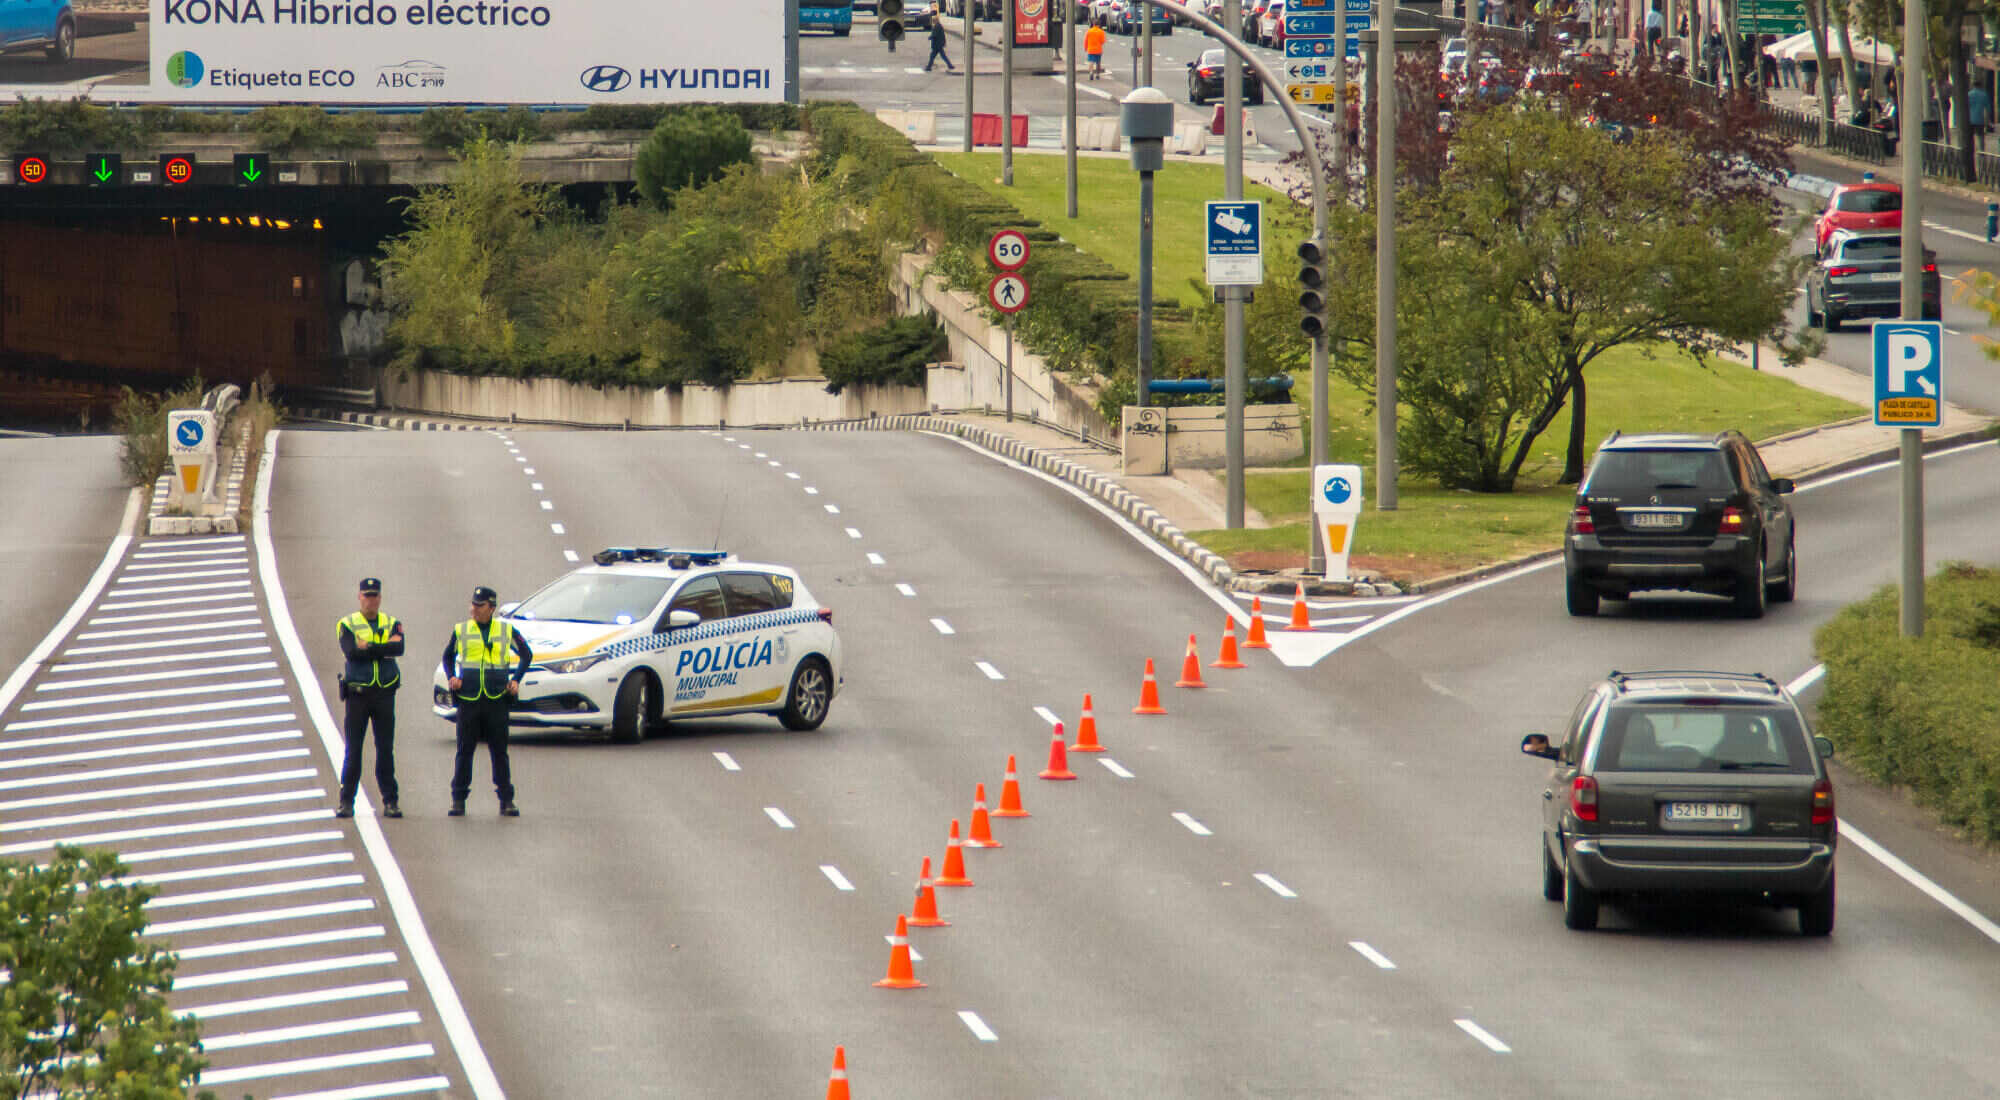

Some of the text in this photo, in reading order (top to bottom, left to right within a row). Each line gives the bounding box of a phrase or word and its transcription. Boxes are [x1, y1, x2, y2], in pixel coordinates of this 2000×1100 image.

[165, 0, 264, 25] KONA
[407, 0, 551, 26] eléctrico
[211, 69, 355, 91] Etiqueta ECO
[376, 72, 419, 88] ABC
[640, 69, 770, 89] HYUNDAI
[25, 164, 40, 176] 50
[171, 165, 186, 177] 50
[1000, 243, 1022, 257] 50
[1888, 334, 1932, 392] P
[1900, 400, 1906, 409] DE
[675, 635, 772, 676] POLICÍA
[676, 671, 738, 691] MUNICIPAL
[674, 690, 706, 701] MADRID
[1675, 803, 1740, 818] 5219 DTJ
